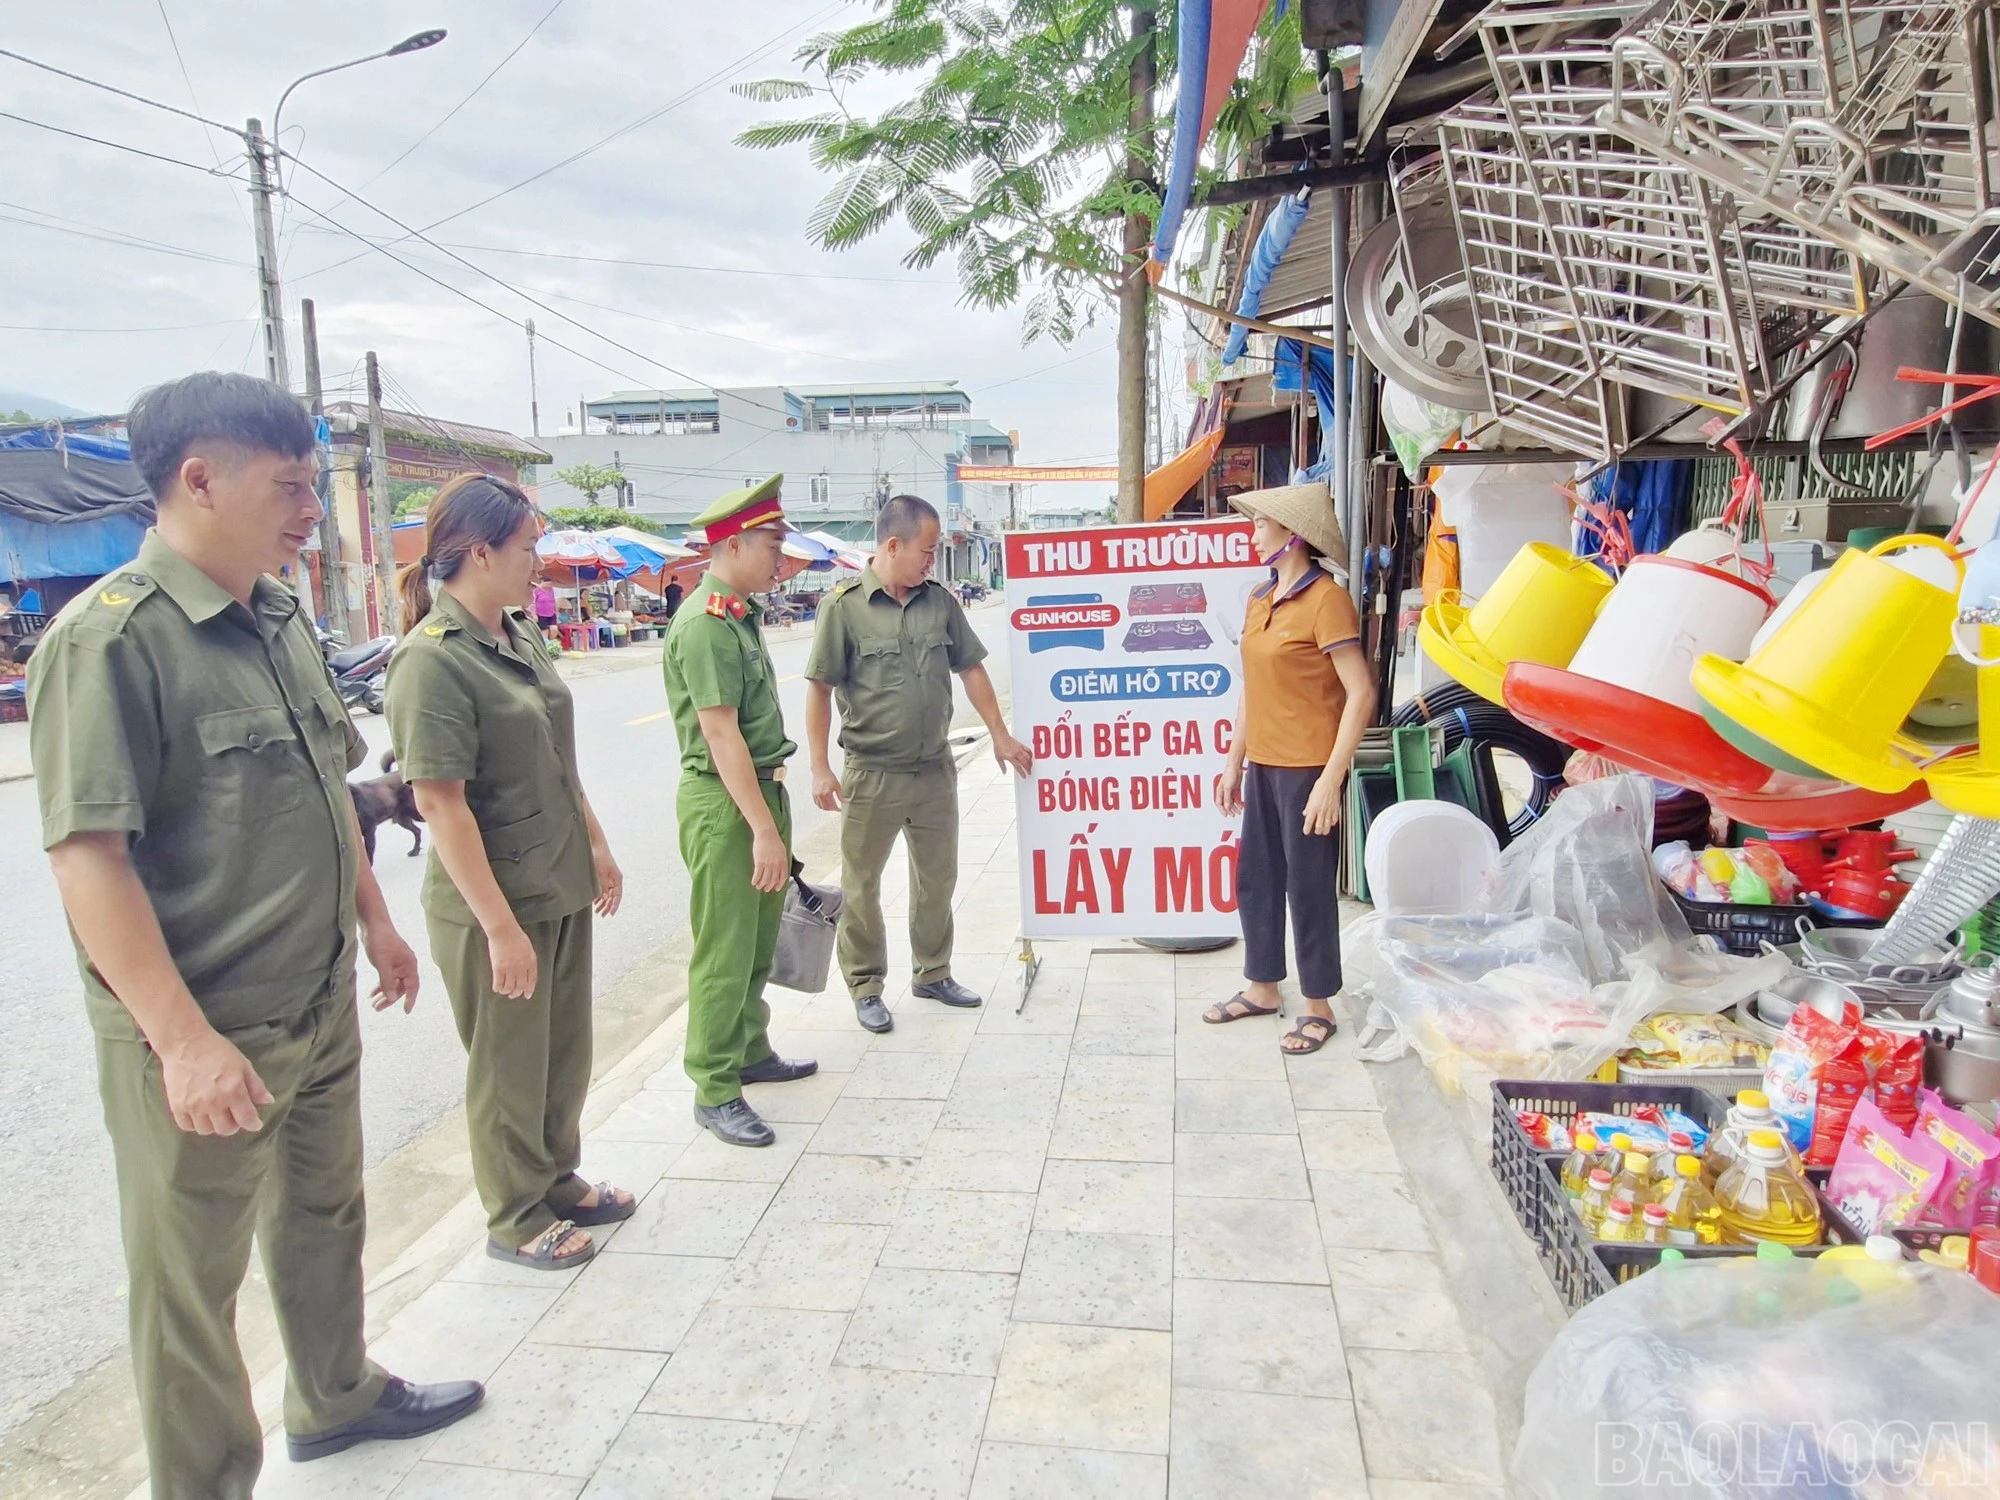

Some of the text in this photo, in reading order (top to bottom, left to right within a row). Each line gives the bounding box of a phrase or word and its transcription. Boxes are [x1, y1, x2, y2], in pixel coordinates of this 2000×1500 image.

[405, 465, 430, 476] TRUNG
[1023, 528, 1250, 572] THU TRƯỜNG
[1020, 609, 1112, 626] SUNHOUSE
[1060, 668, 1221, 696] ĐIỂM HỖ TRỢ
[1032, 709, 1238, 760] ĐỔI BẾP GA C
[1037, 770, 1120, 812] BÓNG
[1130, 767, 1202, 818] ĐIỆN
[1032, 823, 1133, 914] LẤY
